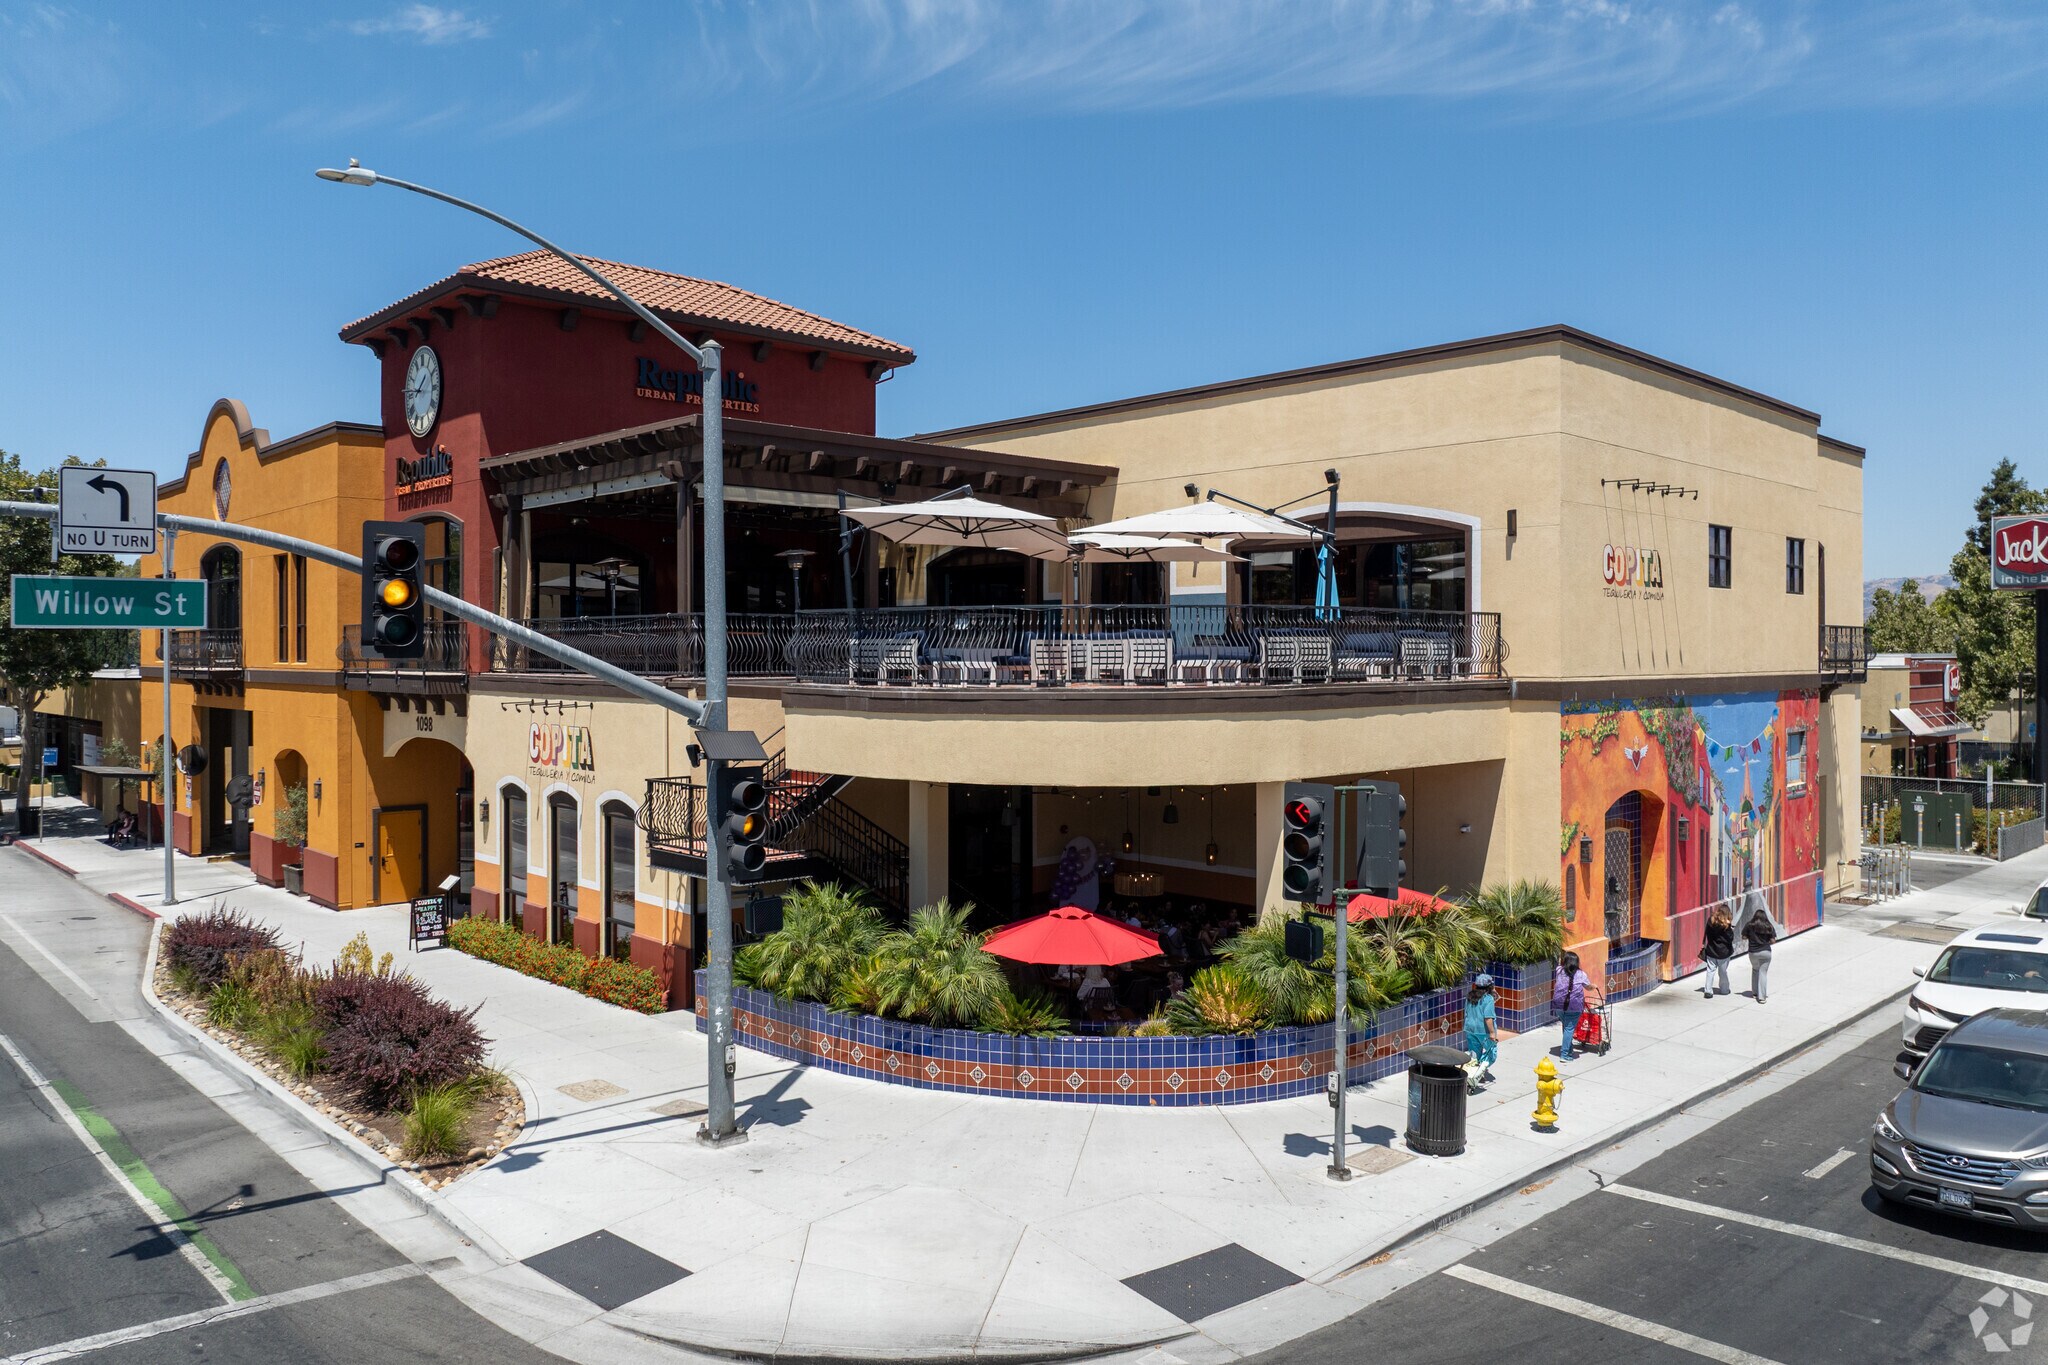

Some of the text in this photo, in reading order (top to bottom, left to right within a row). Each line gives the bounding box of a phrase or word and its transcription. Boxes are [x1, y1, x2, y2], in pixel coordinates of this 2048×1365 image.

[637, 387, 760, 413] URBAN PRRTIES
[395, 444, 453, 489] Republic
[67, 530, 149, 548] NO U TURN
[1998, 525, 2048, 566] Jack
[1603, 543, 1664, 588] COPITA
[2002, 575, 2014, 584] in
[2016, 574, 2037, 584] the
[35, 589, 187, 616] Willow St
[416, 715, 433, 731] 1098
[529, 722, 595, 771] COPITA
[529, 766, 563, 780] TEQUILERIA
[571, 773, 596, 784] COMIDA
